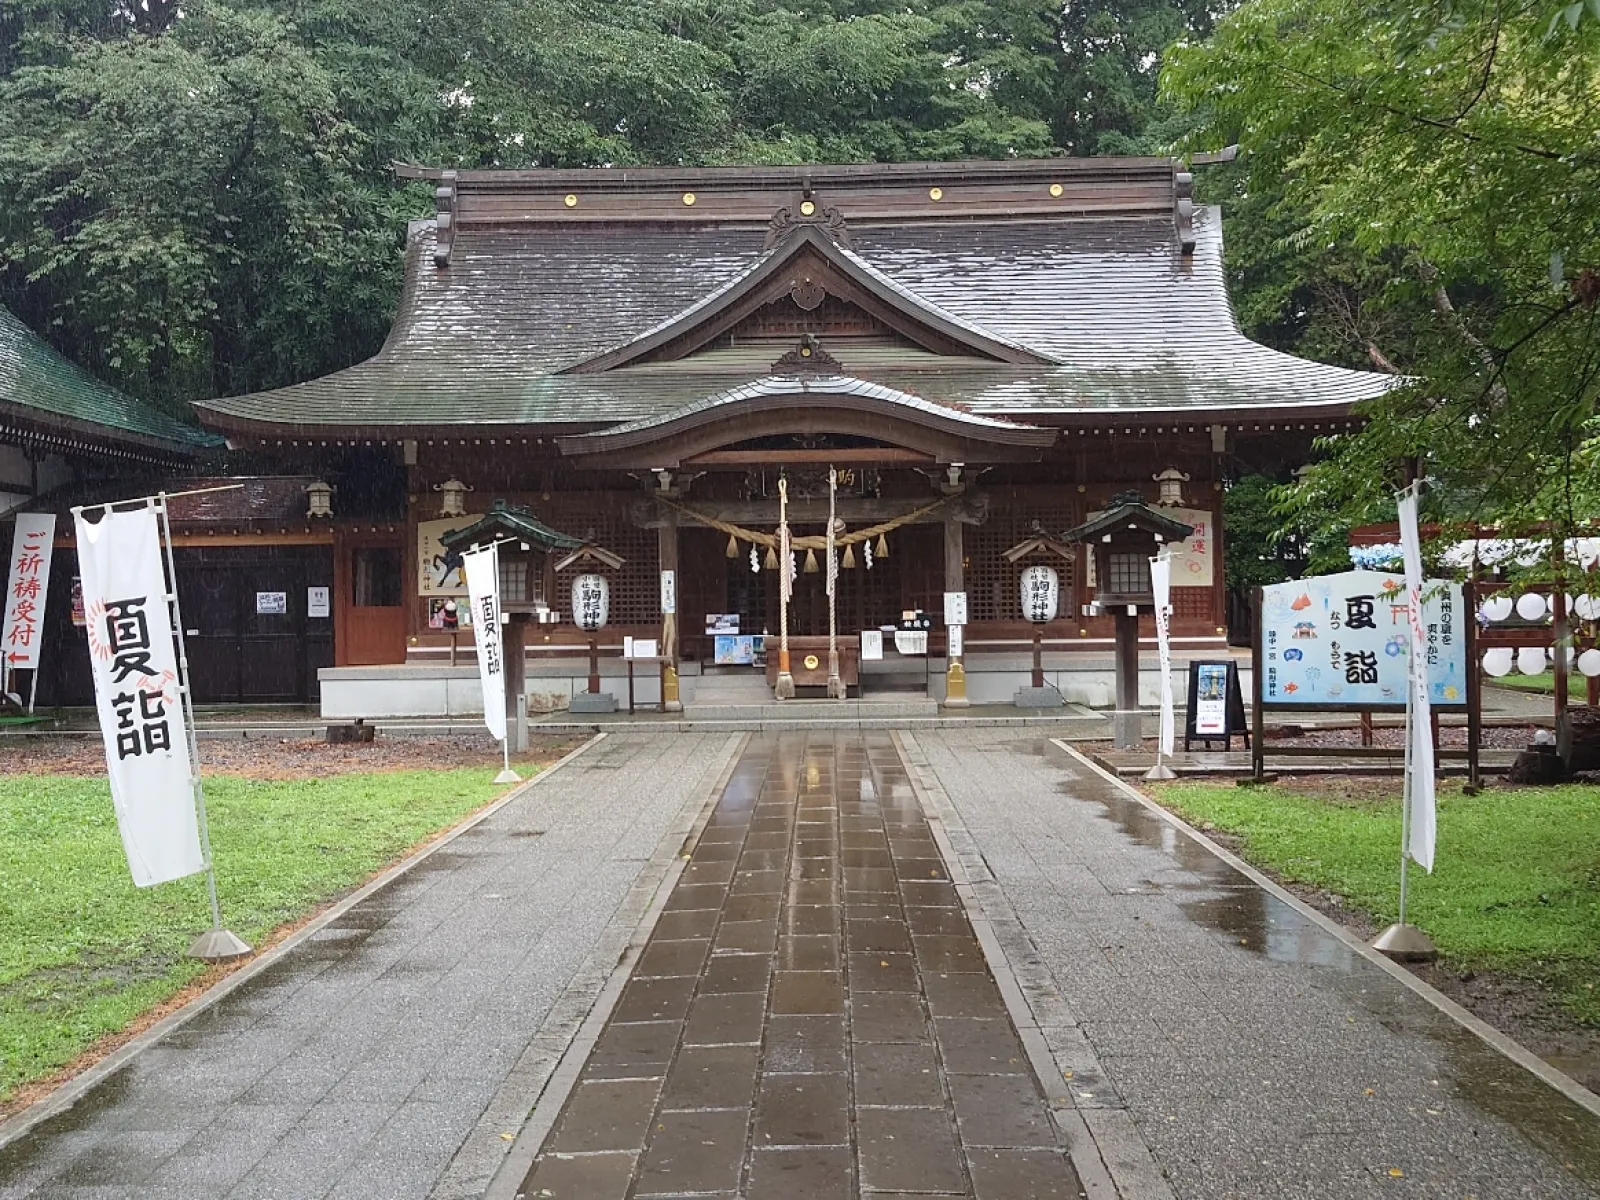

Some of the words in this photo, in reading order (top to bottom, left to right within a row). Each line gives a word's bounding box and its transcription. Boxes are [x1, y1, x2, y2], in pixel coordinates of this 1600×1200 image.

[1192, 522, 1206, 555] 開運
[7, 531, 46, 647] ご祈祷受付
[1330, 610, 1341, 630] なつ
[1344, 594, 1378, 684] 夏詣
[104, 595, 172, 761] 夏詣
[1330, 641, 1341, 670] もうで
